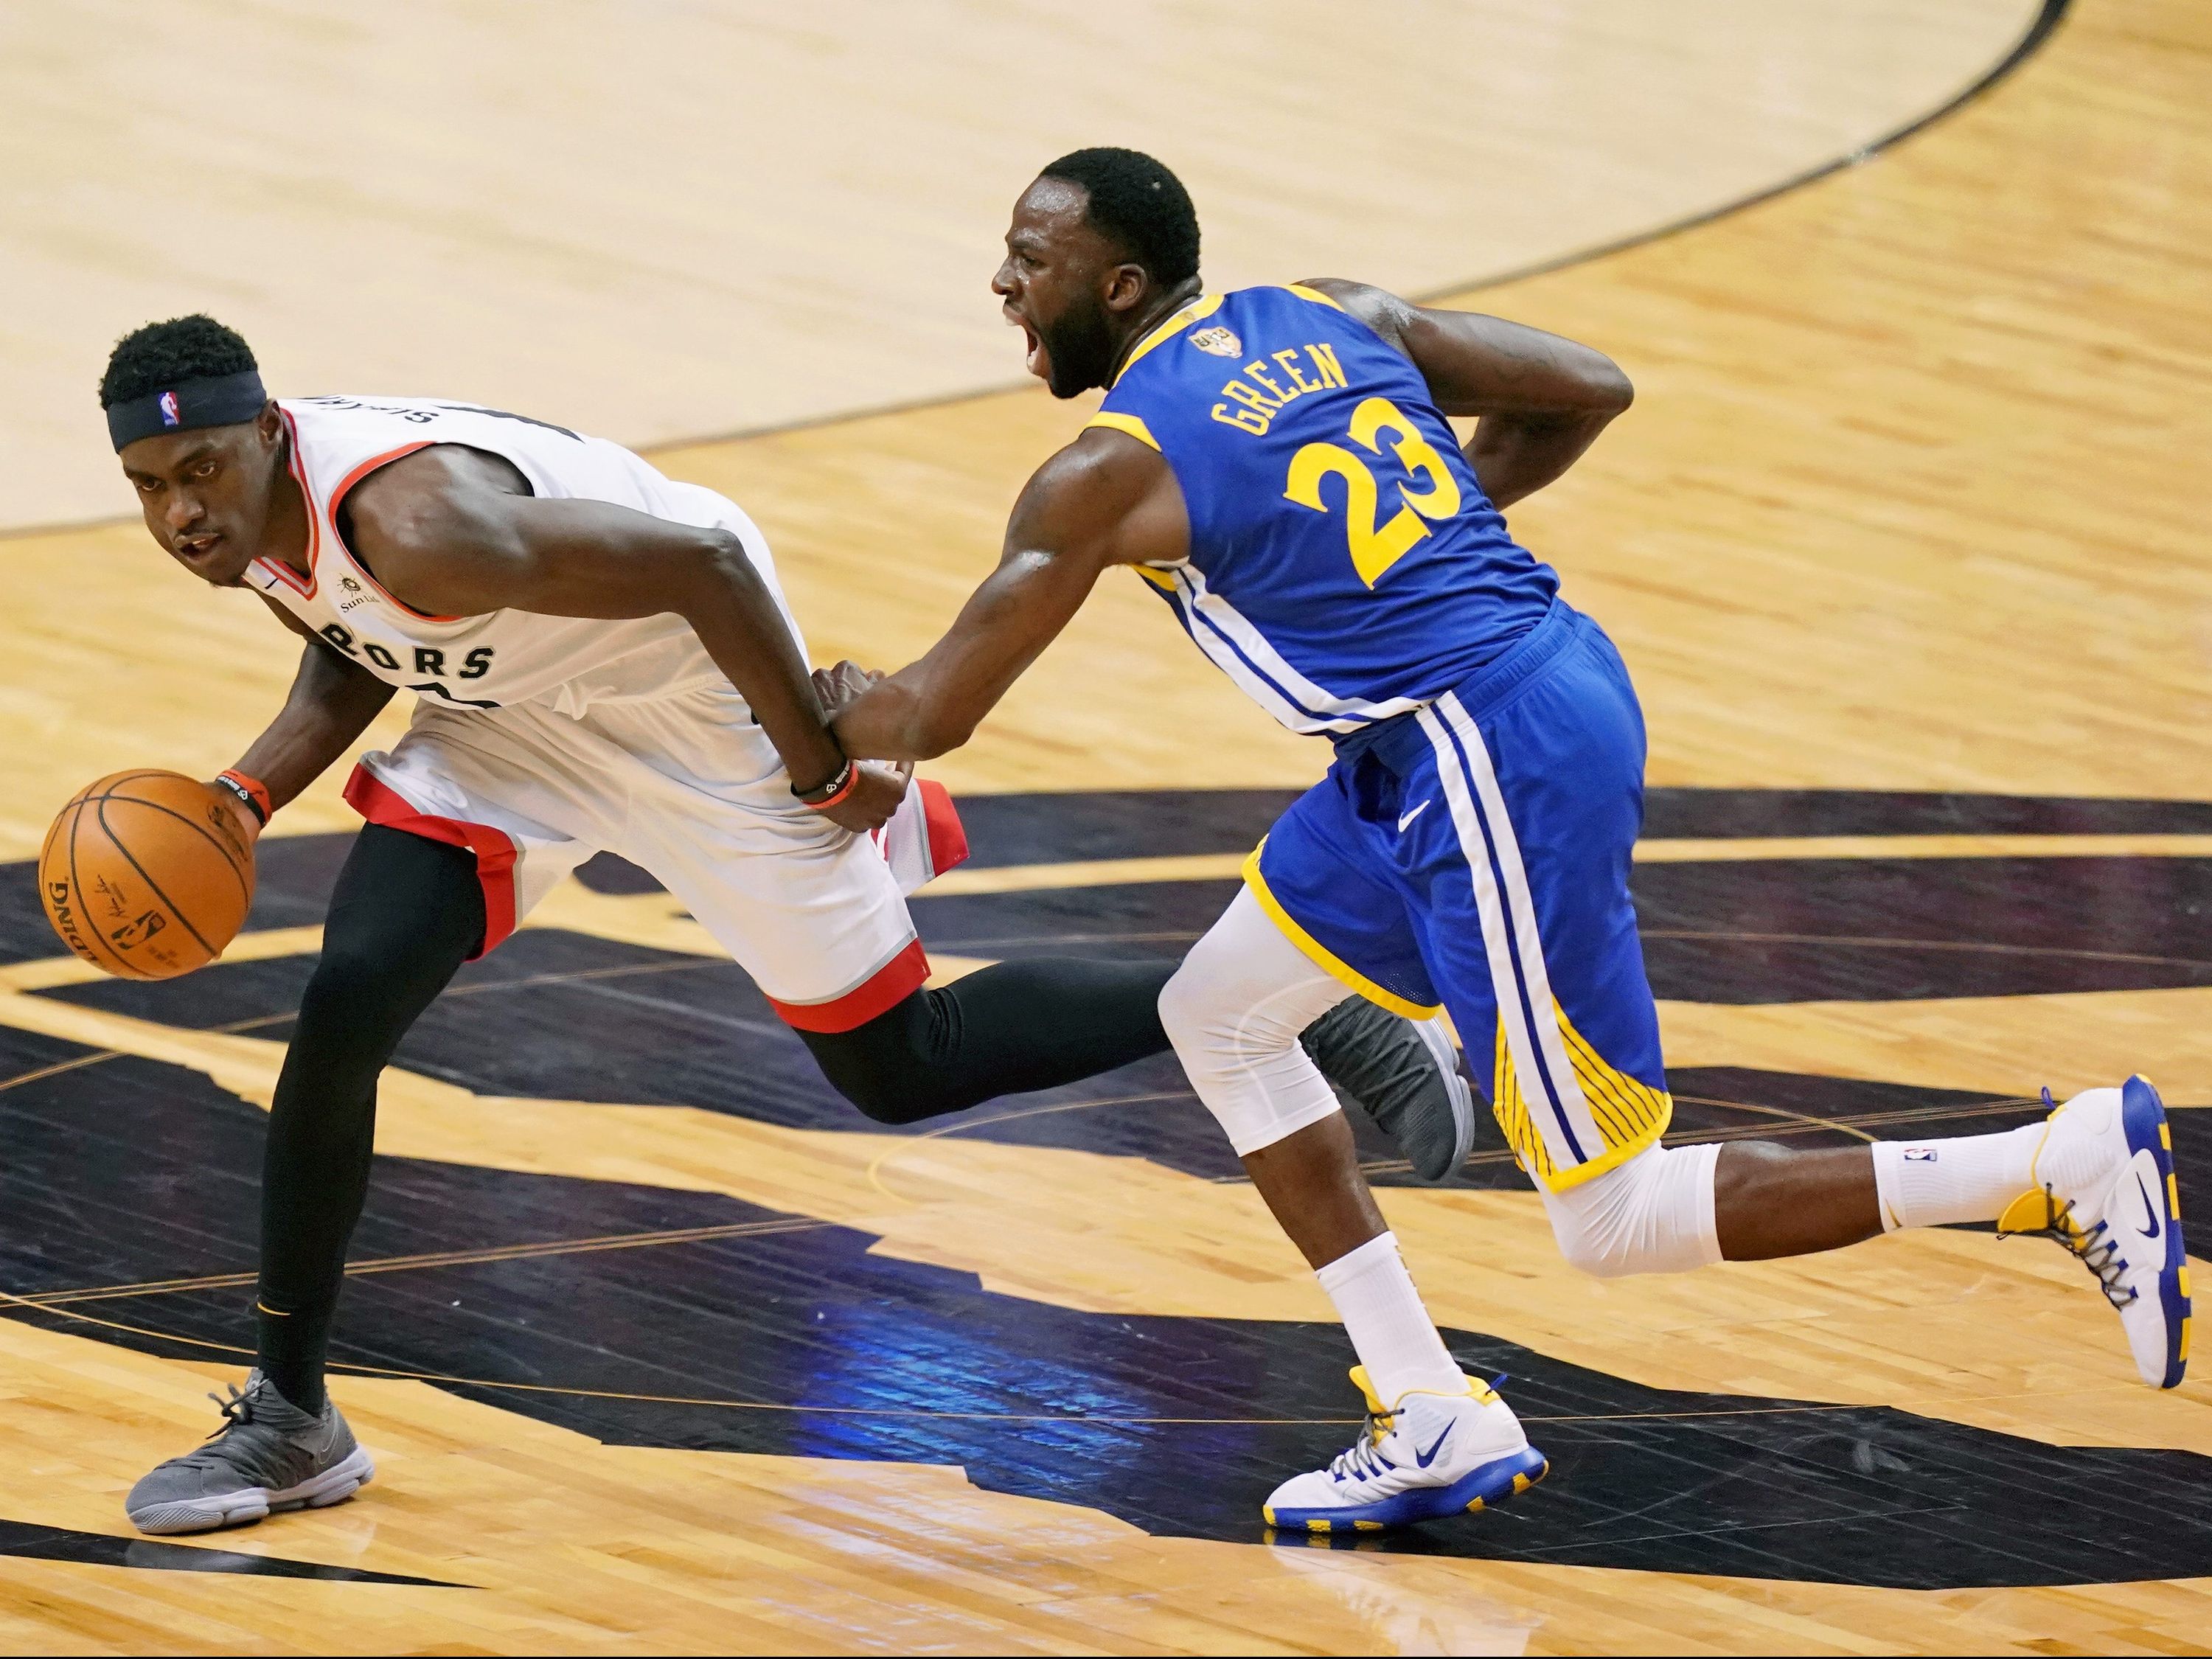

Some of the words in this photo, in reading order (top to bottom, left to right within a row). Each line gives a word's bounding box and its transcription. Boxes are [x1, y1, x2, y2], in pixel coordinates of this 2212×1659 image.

[1211, 343, 1349, 437] GREEN
[1282, 397, 1461, 591] 23
[340, 597, 365, 613] Sun
[317, 622, 496, 680] PORS
